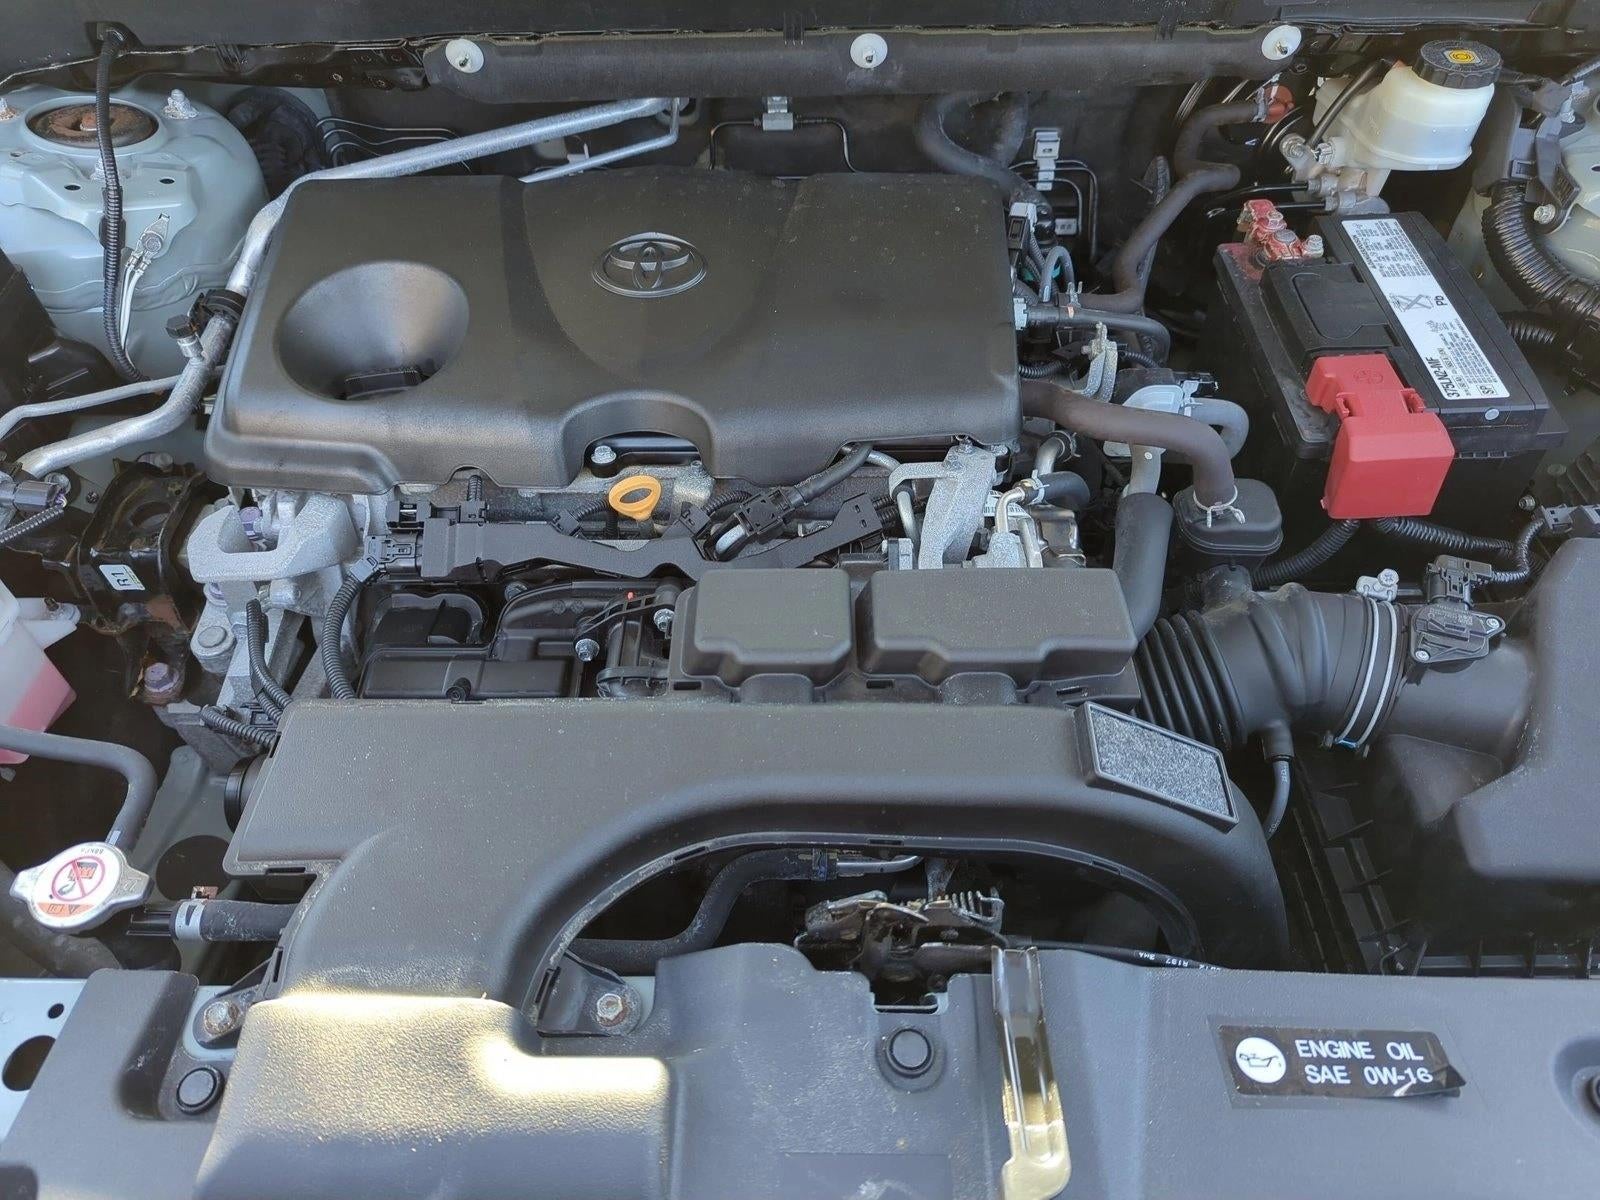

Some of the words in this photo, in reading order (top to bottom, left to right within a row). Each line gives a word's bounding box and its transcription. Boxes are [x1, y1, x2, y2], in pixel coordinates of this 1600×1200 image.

[1434, 295, 1447, 306] Pb
[111, 572, 131, 587] R1
[1295, 1040, 1375, 1059] ENGINE
[1386, 1041, 1424, 1060] OIL
[1304, 1064, 1351, 1084] SAE
[1363, 1066, 1434, 1085] 0W-16
